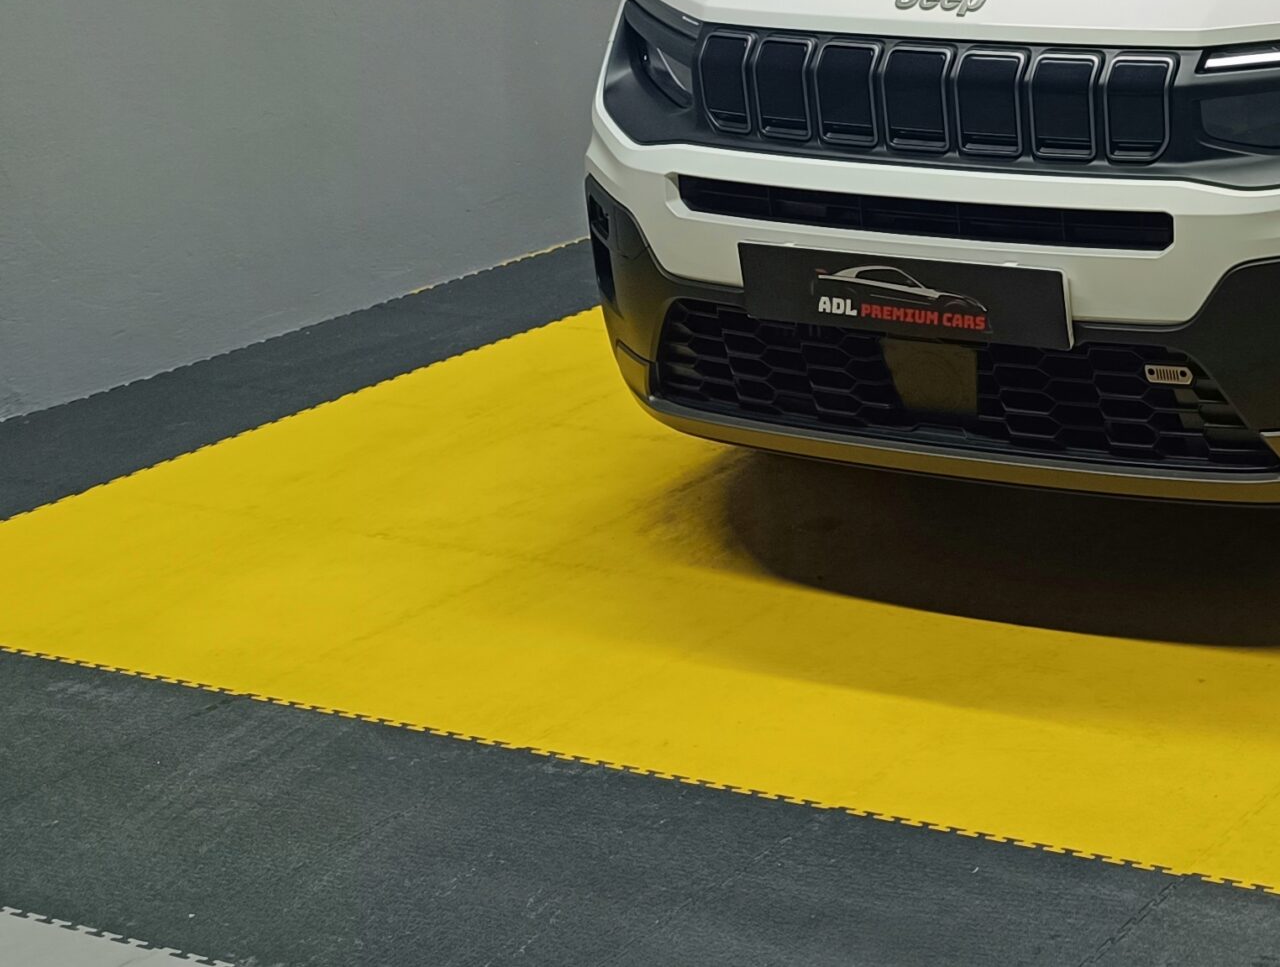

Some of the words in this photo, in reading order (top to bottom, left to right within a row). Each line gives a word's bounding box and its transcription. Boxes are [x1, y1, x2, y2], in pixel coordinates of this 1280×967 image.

[818, 296, 857, 317] ADL
[861, 303, 939, 326] PREMIUM
[942, 312, 986, 331] CARS
